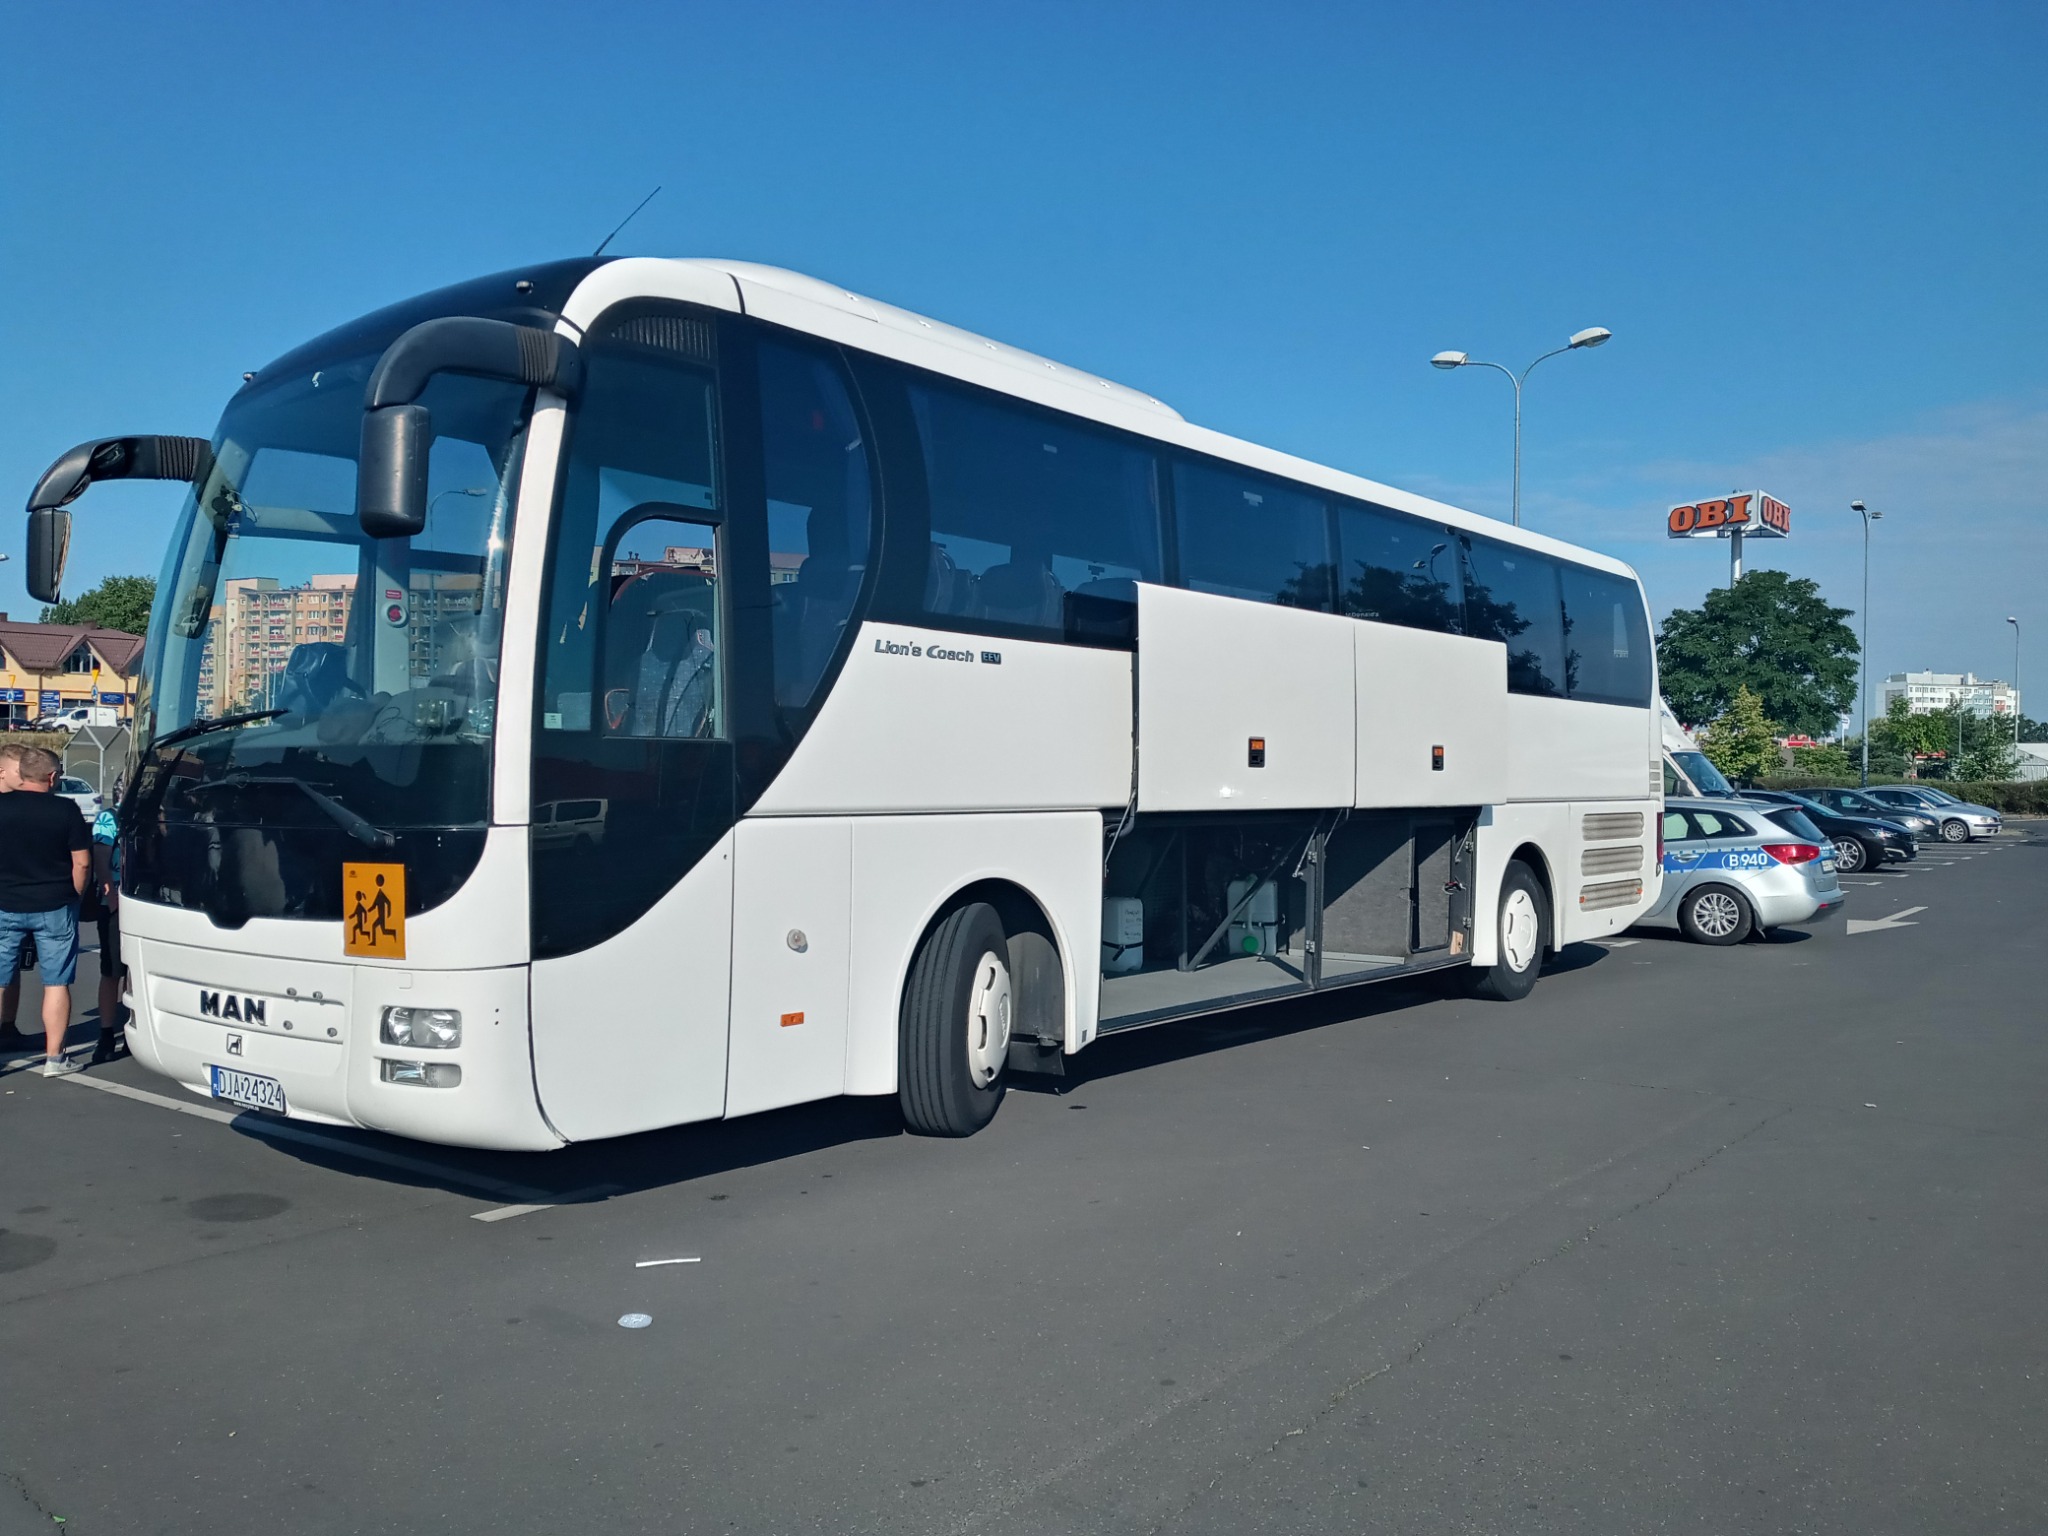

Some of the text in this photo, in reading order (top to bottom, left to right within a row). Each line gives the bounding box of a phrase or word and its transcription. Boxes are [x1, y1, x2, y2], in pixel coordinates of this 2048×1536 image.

[1668, 495, 1753, 533] OBI
[1761, 496, 1790, 532] OBI
[875, 639, 1000, 663] Lion's Coach EEV
[200, 990, 267, 1027] MAN
